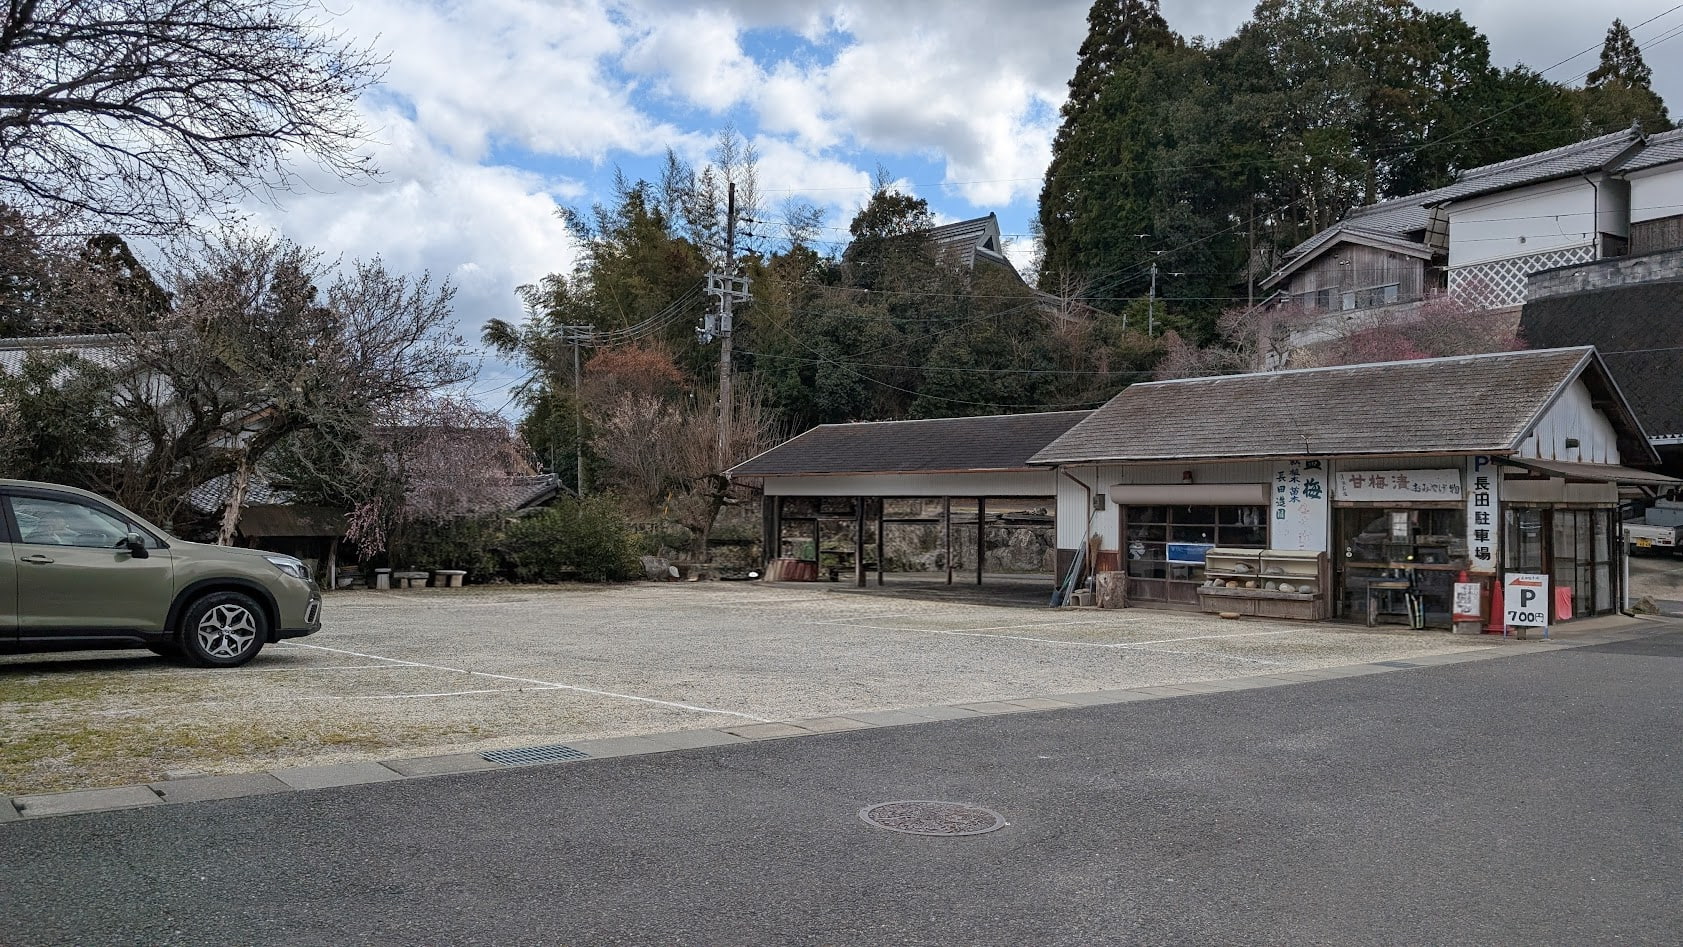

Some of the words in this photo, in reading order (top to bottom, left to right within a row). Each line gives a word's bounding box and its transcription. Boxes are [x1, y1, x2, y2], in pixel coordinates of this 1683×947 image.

[1474, 455, 1489, 472] P
[1349, 474, 1410, 490] 甘梅漬
[1411, 482, 1460, 494] おみやげ物
[1474, 476, 1491, 561] 長田駐車場
[1520, 588, 1536, 608] P
[1507, 610, 1544, 623] 700円
